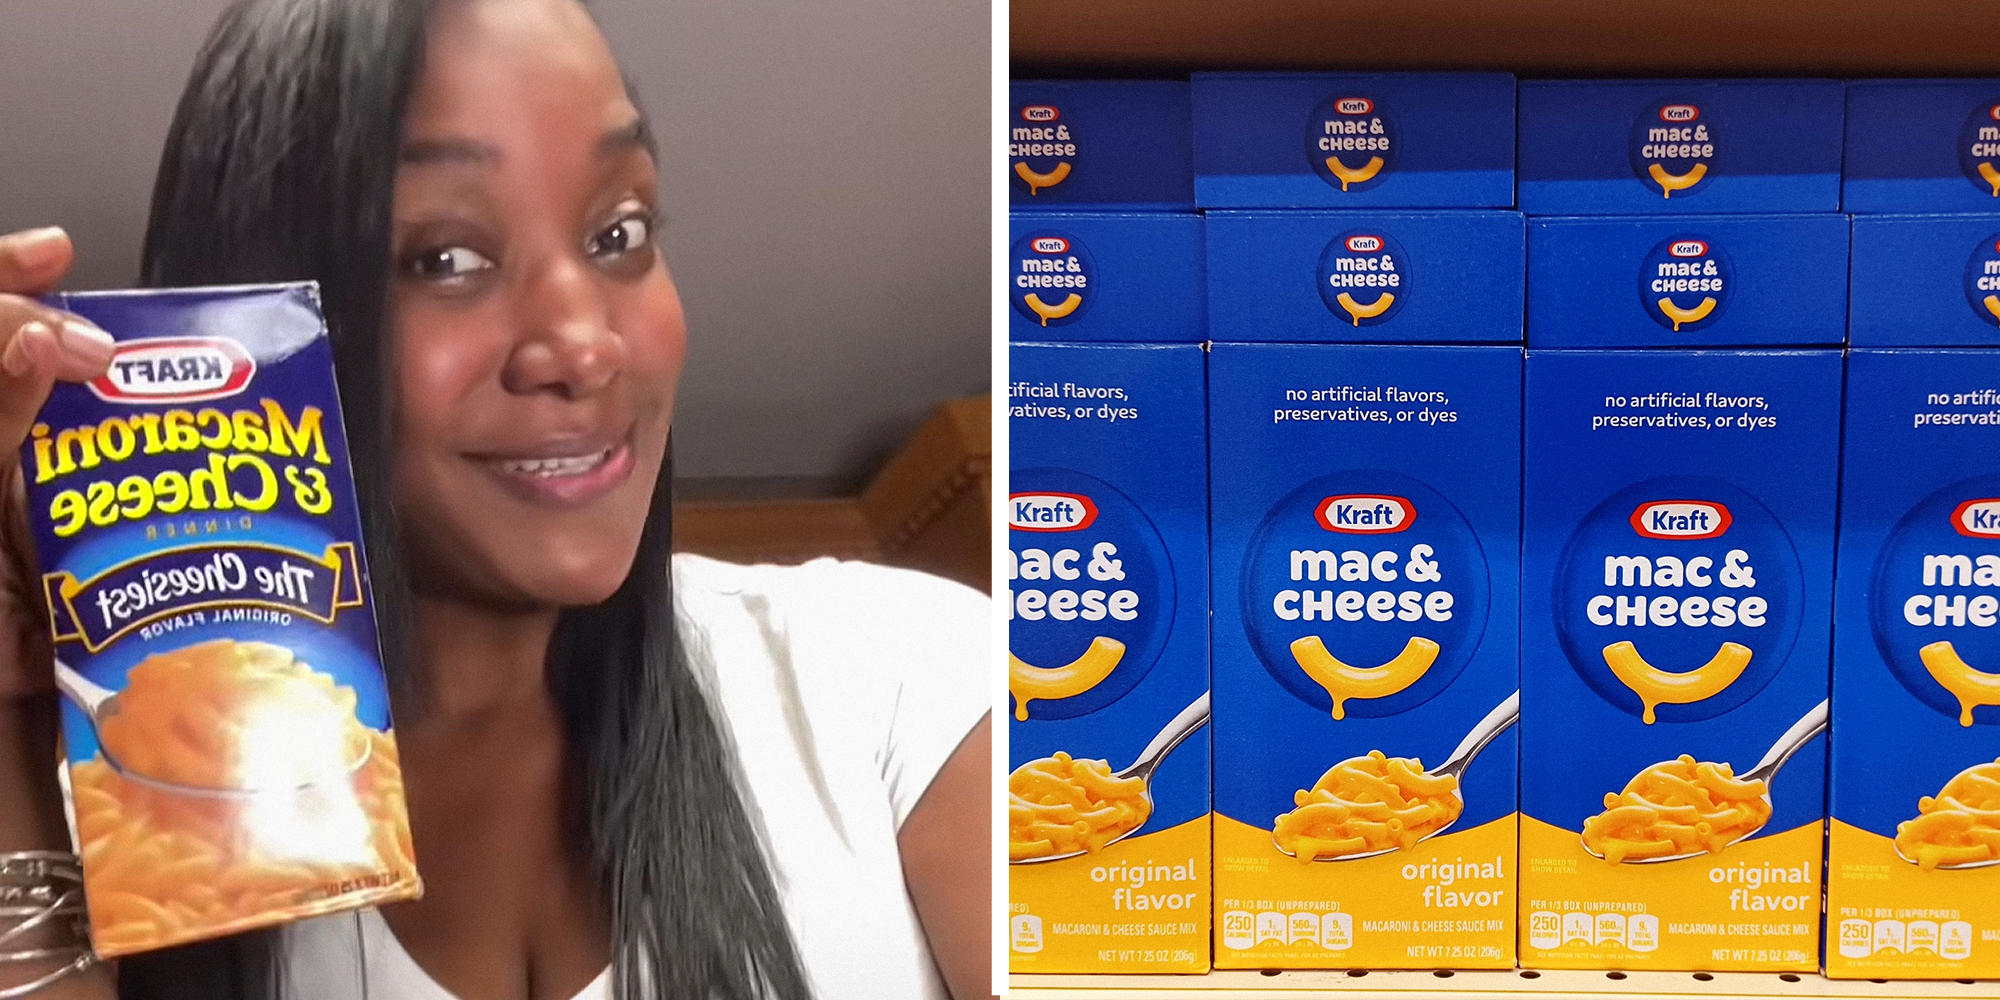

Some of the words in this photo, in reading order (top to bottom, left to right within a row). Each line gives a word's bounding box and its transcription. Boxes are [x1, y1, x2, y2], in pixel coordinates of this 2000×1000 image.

[1030, 110, 1051, 119] Kraft
[1343, 101, 1365, 112] Kraft
[1667, 108, 1690, 120] Kraft
[1013, 127, 1054, 141] mac
[1057, 124, 1070, 141] &
[1325, 119, 1367, 135] mac
[1370, 118, 1384, 135] &
[1649, 127, 1692, 142] mac
[1694, 125, 1708, 142] &
[1039, 241, 1061, 250] Kraft
[1353, 238, 1375, 249] Kraft
[1676, 244, 1699, 255] Kraft
[1022, 259, 1065, 272] mac
[1066, 257, 1081, 273] &
[1336, 256, 1378, 272] mac
[1380, 255, 1395, 272] &
[1658, 262, 1701, 277] mac
[1703, 260, 1718, 277] &
[1063, 383, 1128, 402] flavors,
[1286, 389, 1308, 401] no
[1311, 386, 1382, 402] artificial
[1385, 387, 1450, 405] flavors,
[1928, 394, 1950, 405] no
[1605, 396, 1627, 409] no
[1630, 392, 1701, 409] artificial
[1705, 393, 1770, 411] flavors,
[1075, 407, 1094, 418] or
[1097, 404, 1138, 423] dyes
[1273, 406, 1393, 424] preservatives,
[1395, 409, 1416, 422] or
[1419, 406, 1458, 427] dyes
[1592, 412, 1712, 430] preservatives,
[1715, 416, 1734, 428] or
[1738, 412, 1777, 431] dyes
[1016, 502, 1074, 523] Kraft
[1337, 503, 1392, 525] Kraft
[1652, 510, 1708, 531] Kraft
[1087, 542, 1126, 581] &
[1290, 550, 1399, 582] mac
[1405, 544, 1442, 582] &
[1604, 555, 1713, 587] mac
[1719, 549, 1756, 588] &
[1091, 858, 1197, 889] original
[1402, 857, 1504, 886] original
[1709, 862, 1811, 890] original
[1112, 888, 1197, 911] flavor
[1224, 899, 1240, 908] PER
[1242, 900, 1254, 909] 1/3
[1257, 901, 1273, 909] BOX
[1277, 901, 1340, 912] (UNPREPARED)
[1423, 886, 1504, 908] flavor
[1729, 889, 1810, 911] flavor
[1531, 900, 1546, 909] PER
[1549, 901, 1561, 910] 1/3
[1564, 901, 1580, 910] BOX
[1584, 902, 1647, 913] (UNPREPARED)
[1841, 907, 1857, 917] PER
[1860, 908, 1872, 917] 1/3
[1875, 908, 1892, 918] BOX
[1896, 909, 1960, 920] (UNPREPARED)
[1053, 923, 1101, 935] MACARONI
[1103, 924, 1111, 936] &
[1112, 924, 1145, 936] CHEESE
[1148, 923, 1177, 936] SAUCE
[1180, 923, 1197, 934] MIX
[1227, 915, 1251, 930] 250
[1363, 921, 1411, 932] MACARONI
[1413, 921, 1419, 932] &
[1422, 921, 1454, 932] CHEESE
[1456, 920, 1484, 932] SAUCE
[1487, 920, 1503, 931] MIX
[1533, 916, 1558, 930] 250
[1669, 923, 1717, 934] MACARONI
[1719, 924, 1725, 935] &
[1728, 924, 1760, 935] CHEESE
[1762, 924, 1791, 935] SAUCE
[1793, 924, 1809, 934] MIX
[1843, 924, 1869, 938] 250
[1099, 951, 1117, 962] NET
[1119, 951, 1135, 962] WT
[1158, 951, 1169, 962] OZ
[1171, 951, 1197, 964] (206g)
[1407, 946, 1425, 957] NET
[1427, 946, 1443, 957] WT
[1464, 946, 1476, 957] OZ
[1478, 946, 1503, 960] (206g)
[1712, 949, 1730, 960] NET
[1733, 949, 1748, 960] WT
[1770, 950, 1781, 961] OZ
[1783, 950, 1809, 963] (206g)
